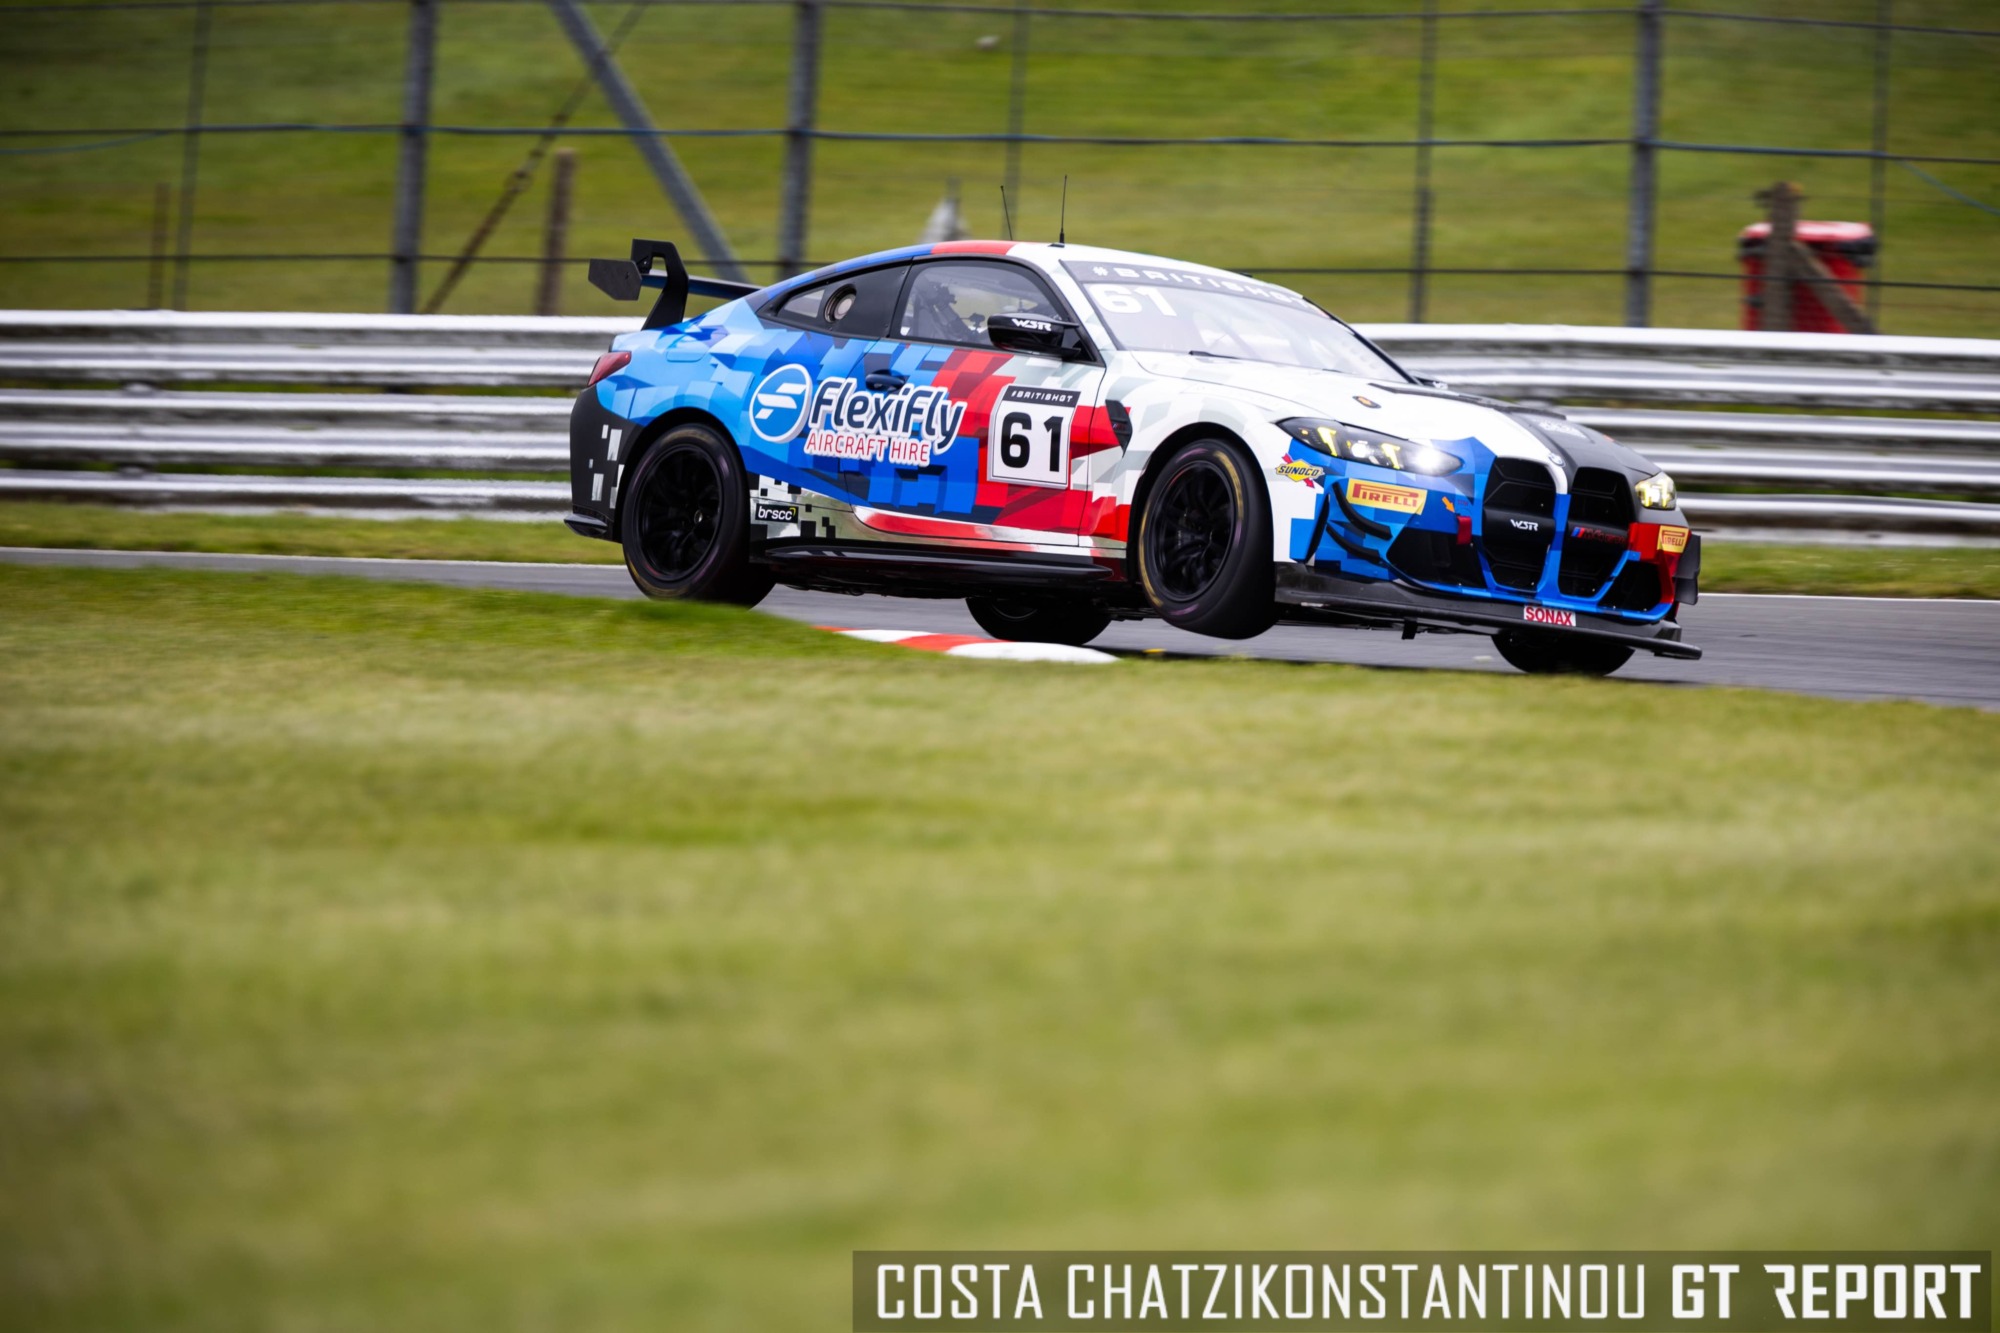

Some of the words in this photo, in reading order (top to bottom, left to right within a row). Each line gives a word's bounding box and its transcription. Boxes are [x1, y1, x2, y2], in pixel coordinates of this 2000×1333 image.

[1087, 284, 1177, 317] 61
[1011, 318, 1052, 332] WSR
[806, 432, 886, 457] AIRCRAFT
[891, 439, 929, 463] HIRE
[1000, 411, 1064, 473] 61
[1277, 465, 1320, 478] SUNOCO
[1352, 483, 1419, 508] PIRELLI
[757, 505, 793, 521] brscc
[1510, 519, 1539, 532] WSR
[1661, 530, 1685, 547] PIRELLI
[1525, 606, 1574, 627] SONAX
